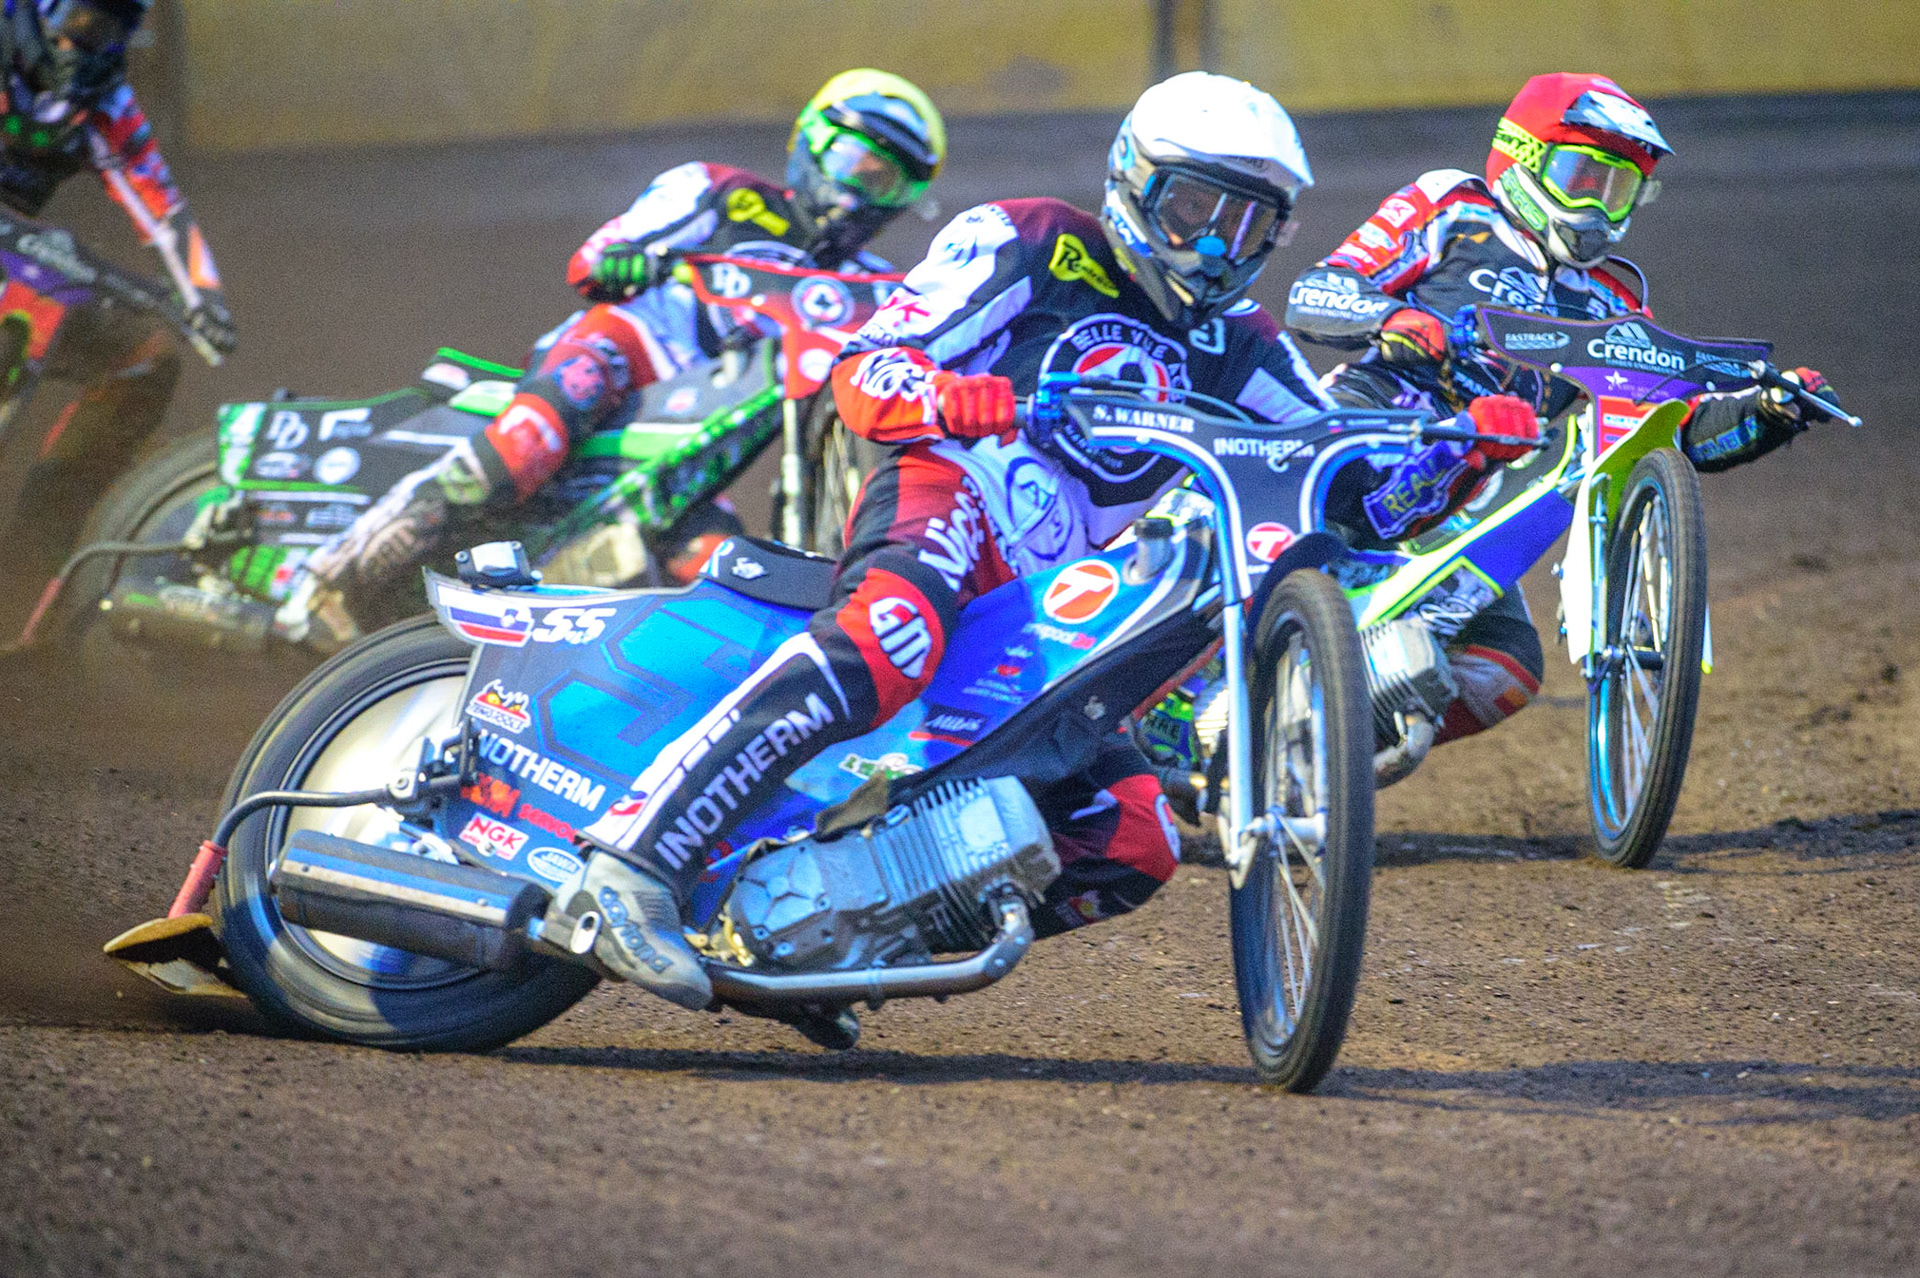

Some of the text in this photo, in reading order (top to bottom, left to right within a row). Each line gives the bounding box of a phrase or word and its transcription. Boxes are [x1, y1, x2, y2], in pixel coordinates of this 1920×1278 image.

[1071, 324, 1122, 350] BELLE
[1587, 338, 1686, 372] Crendon
[1114, 408, 1195, 433] WARNER
[1213, 437, 1316, 458] INOTHERM
[479, 729, 606, 812] NOTHERM
[655, 693, 834, 870] INOTHERM
[468, 817, 523, 850] NGK
